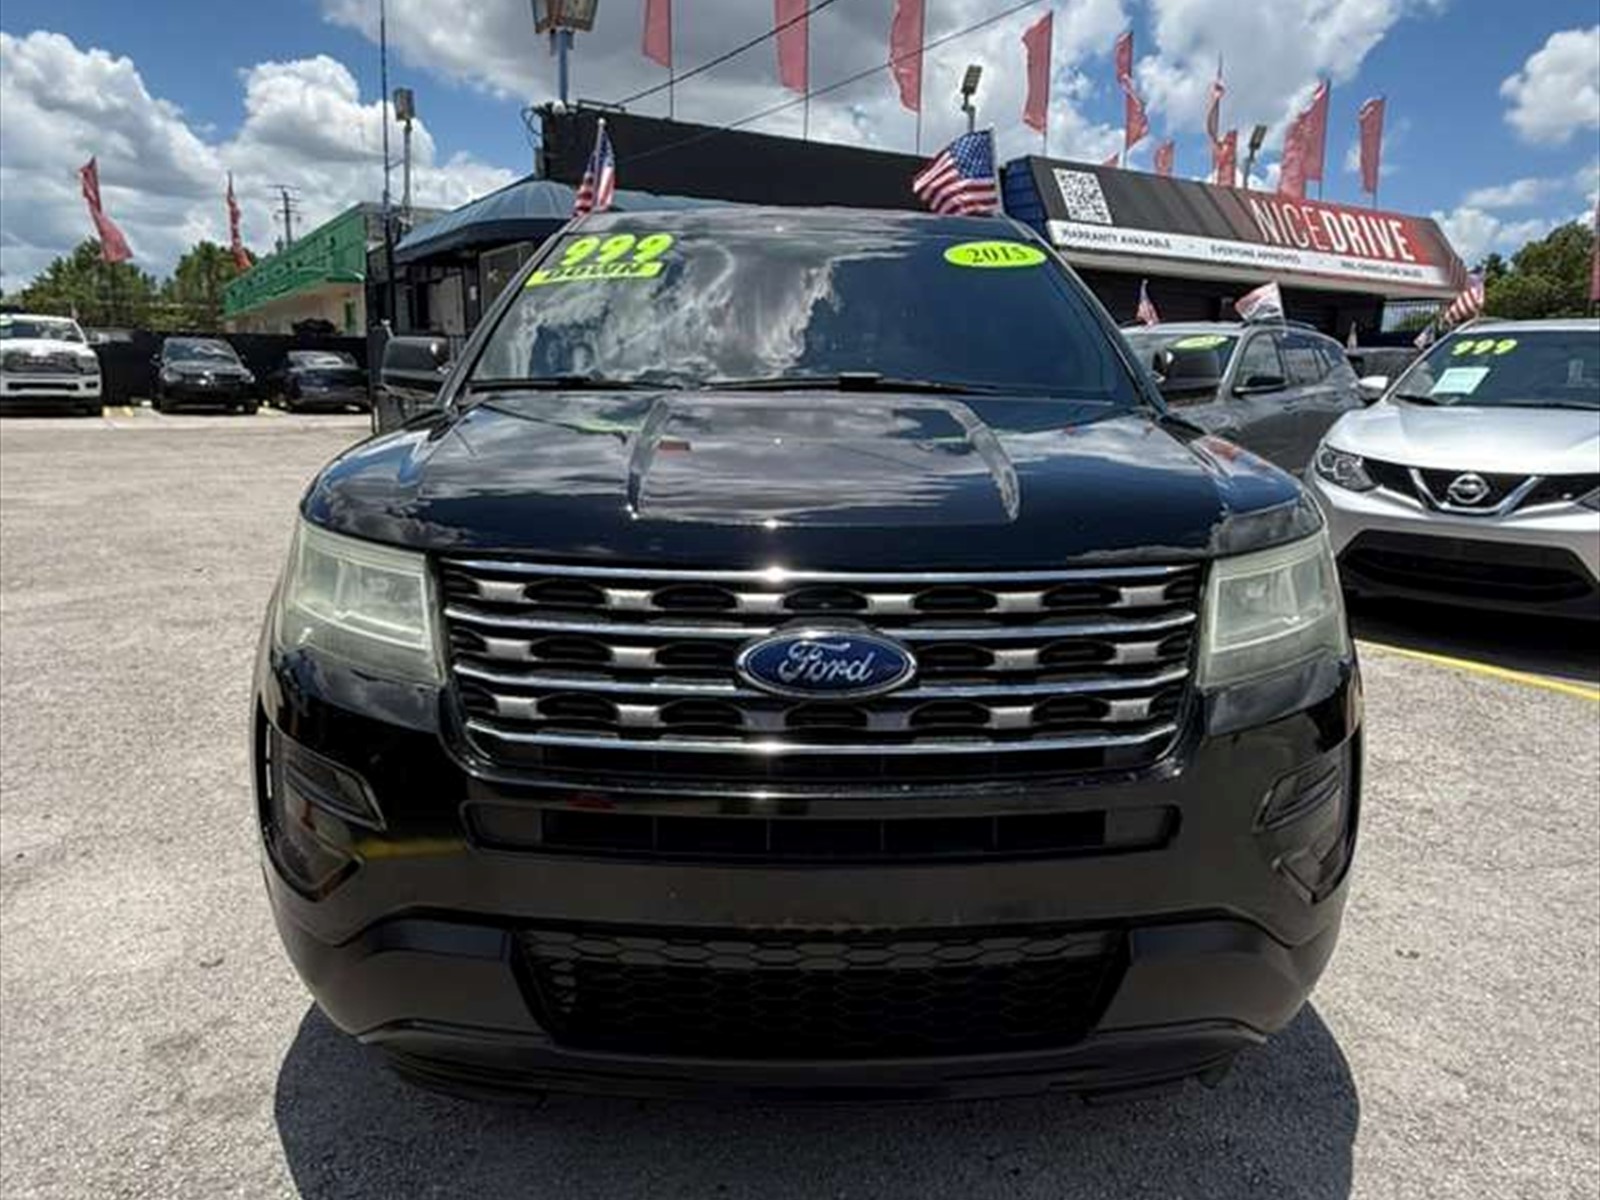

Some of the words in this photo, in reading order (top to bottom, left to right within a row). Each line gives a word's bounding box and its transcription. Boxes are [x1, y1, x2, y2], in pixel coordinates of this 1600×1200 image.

[1062, 228, 1118, 243] WARRANTY
[1121, 235, 1172, 249] AVAILABLE
[1250, 198, 1415, 261] NICEDRIVE
[561, 233, 674, 265] 999
[966, 246, 1028, 263] 2015
[1452, 338, 1518, 355] 999
[778, 640, 875, 682] Ford
